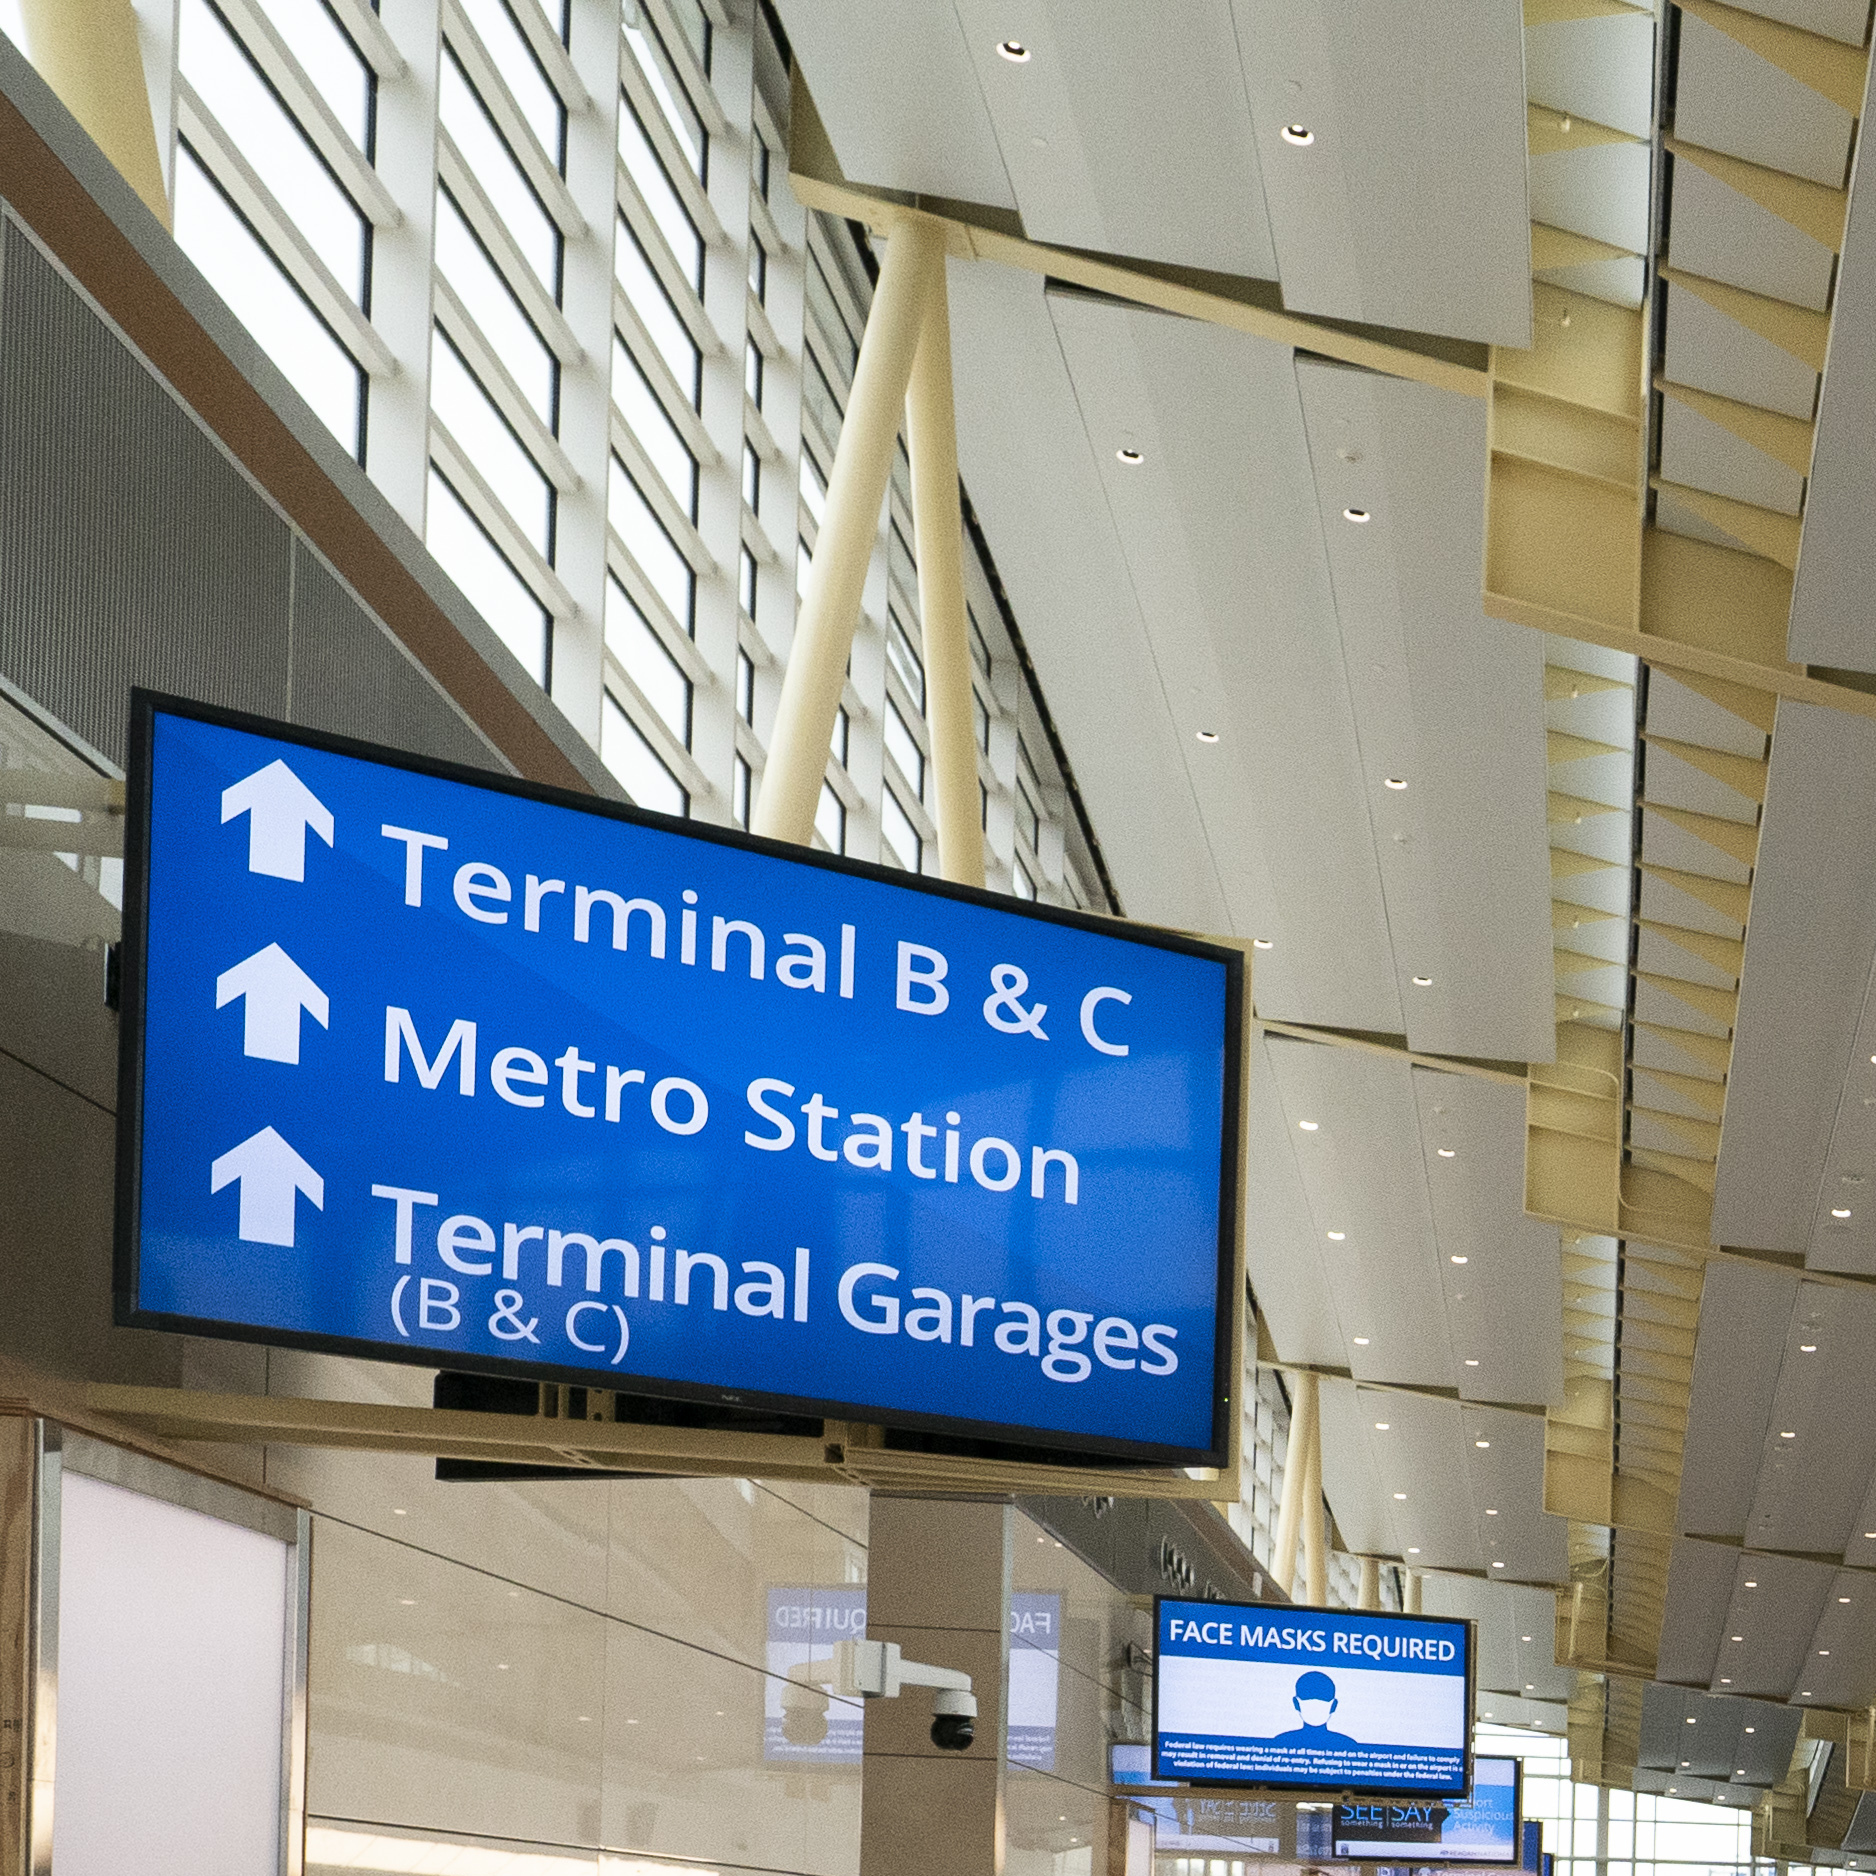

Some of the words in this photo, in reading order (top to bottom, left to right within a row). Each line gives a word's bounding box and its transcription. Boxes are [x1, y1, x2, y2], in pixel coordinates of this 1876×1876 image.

[381, 824, 855, 999] Terminal
[896, 941, 949, 1015] B
[983, 964, 1049, 1040] &
[1080, 985, 1132, 1056] C
[384, 1006, 709, 1135] Metro
[745, 1078, 1079, 1205] Station
[371, 1184, 810, 1322] Terminal
[838, 1262, 1178, 1382] Garages
[391, 1275, 461, 1337] (B
[488, 1289, 540, 1344] &
[565, 1301, 630, 1365] C)
[1170, 1619, 1232, 1645] FACE
[1240, 1625, 1326, 1652] MASKS
[1333, 1632, 1456, 1661] REQUIRED
[1165, 1741, 1191, 1749] Federal
[1192, 1742, 1205, 1750] law
[1206, 1743, 1234, 1752] requires
[1236, 1745, 1263, 1754] wearing
[1297, 1747, 1305, 1755] all
[1307, 1748, 1324, 1757] times
[1334, 1750, 1346, 1758] and
[1358, 1750, 1368, 1759] the
[1370, 1751, 1392, 1760] airport
[1394, 1752, 1406, 1760] and
[1407, 1753, 1427, 1762] failure
[1437, 1756, 1460, 1764] comply
[1237, 1753, 1249, 1761] and
[1251, 1754, 1272, 1762] denial
[1282, 1756, 1311, 1766] re-entry.
[1313, 1758, 1342, 1767] Refusing
[1429, 1764, 1451, 1773] airport
[1173, 1760, 1205, 1768] violation
[1214, 1761, 1239, 1770] federal
[1255, 1764, 1292, 1772] individuals
[1293, 1766, 1307, 1774] may
[1319, 1767, 1343, 1776] subject
[1352, 1768, 1382, 1777] penalties
[1384, 1770, 1403, 1778] under
[1404, 1770, 1415, 1778] the
[1415, 1771, 1438, 1780] federal
[1439, 1772, 1452, 1780] law.
[1341, 1805, 1383, 1821] SEE
[1391, 1802, 1434, 1822] SAY
[1341, 1820, 1383, 1830] something
[1391, 1822, 1434, 1831] something
[1453, 1821, 1495, 1836] Activity
